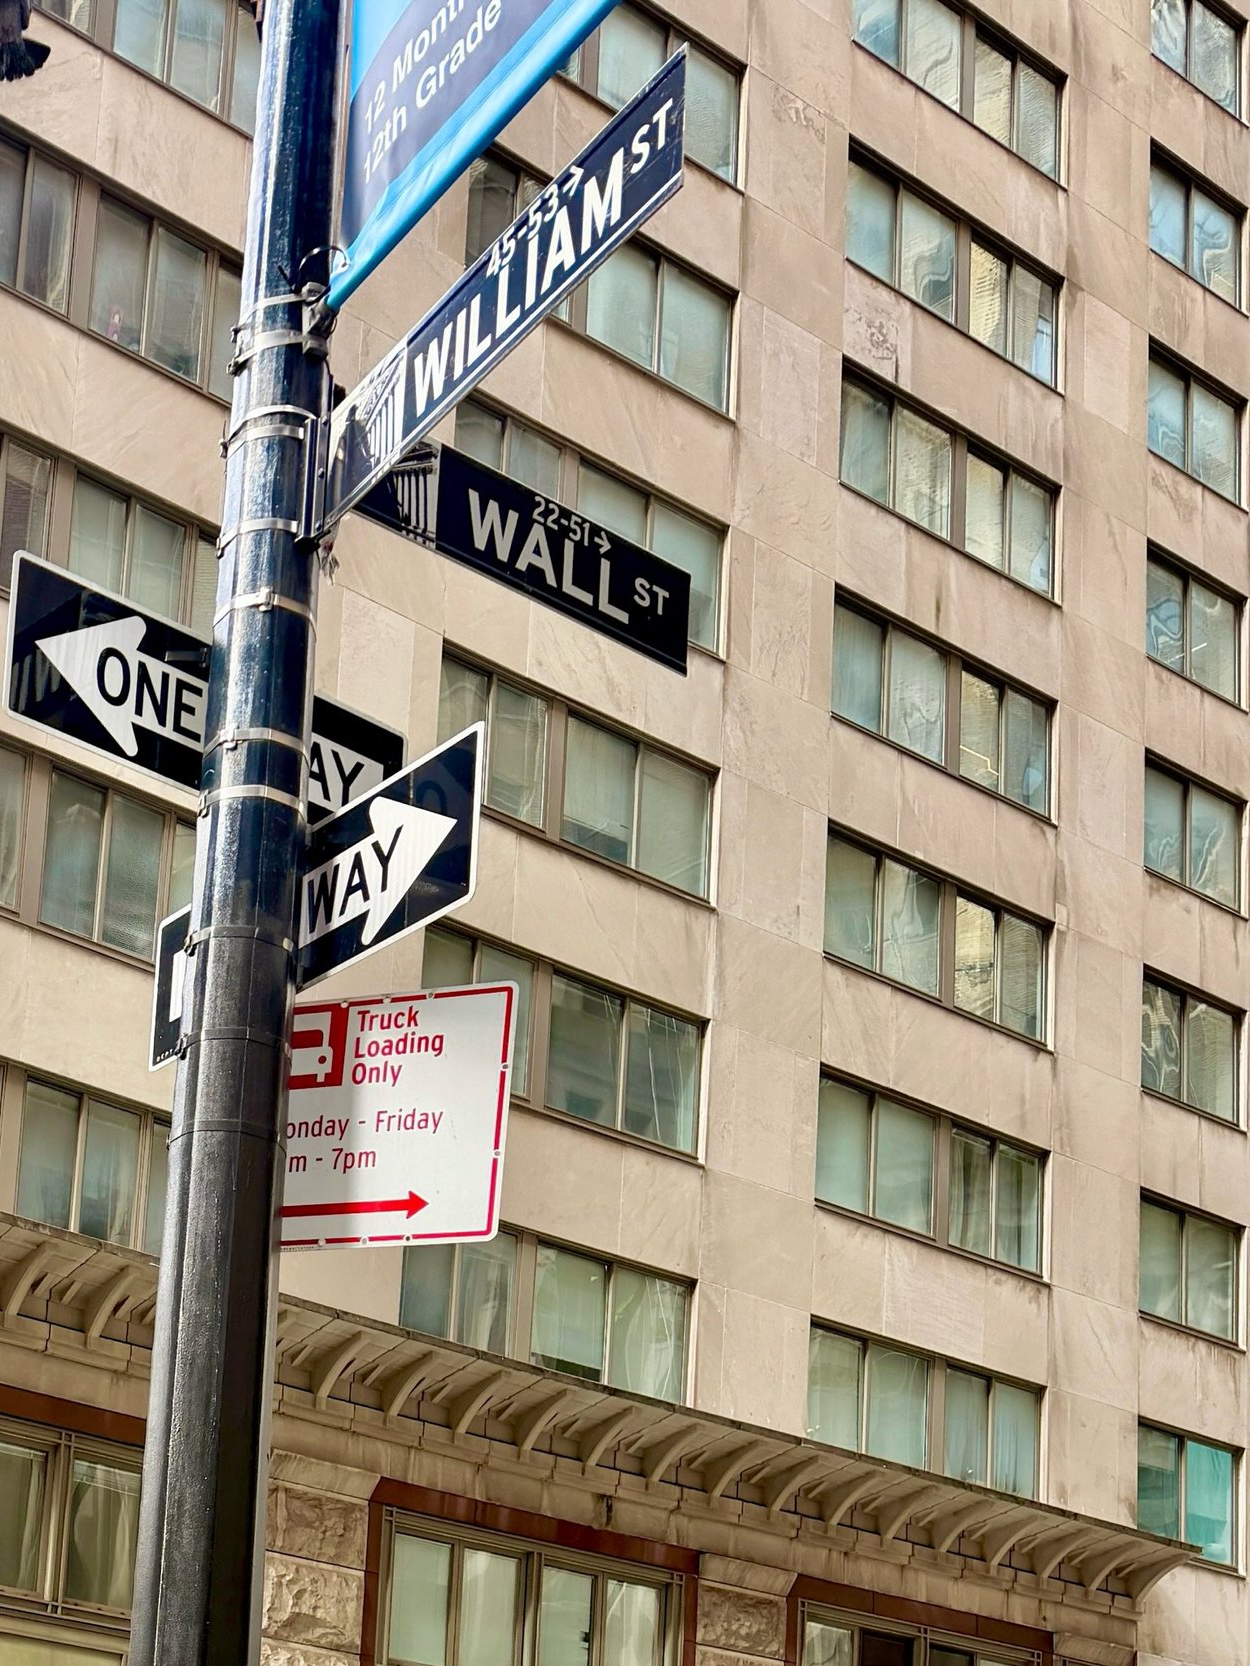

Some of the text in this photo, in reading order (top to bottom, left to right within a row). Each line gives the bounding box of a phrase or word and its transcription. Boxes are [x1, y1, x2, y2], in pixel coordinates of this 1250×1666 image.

[364, 0, 501, 184] 12th Grade
[365, 80, 386, 134] 12
[414, 97, 673, 418] WILLIAM ST
[486, 183, 558, 278] 45-53
[532, 495, 591, 547] 22-51
[468, 487, 670, 625] WALL ST
[97, 646, 365, 803] ONE AY
[307, 823, 405, 934] WAY
[354, 1031, 444, 1059] Loading
[357, 1005, 419, 1032] Truck
[351, 1060, 403, 1087] Only
[286, 1114, 350, 1140] onday
[375, 1108, 444, 1134] Friday
[332, 1148, 377, 1174] 7pm
